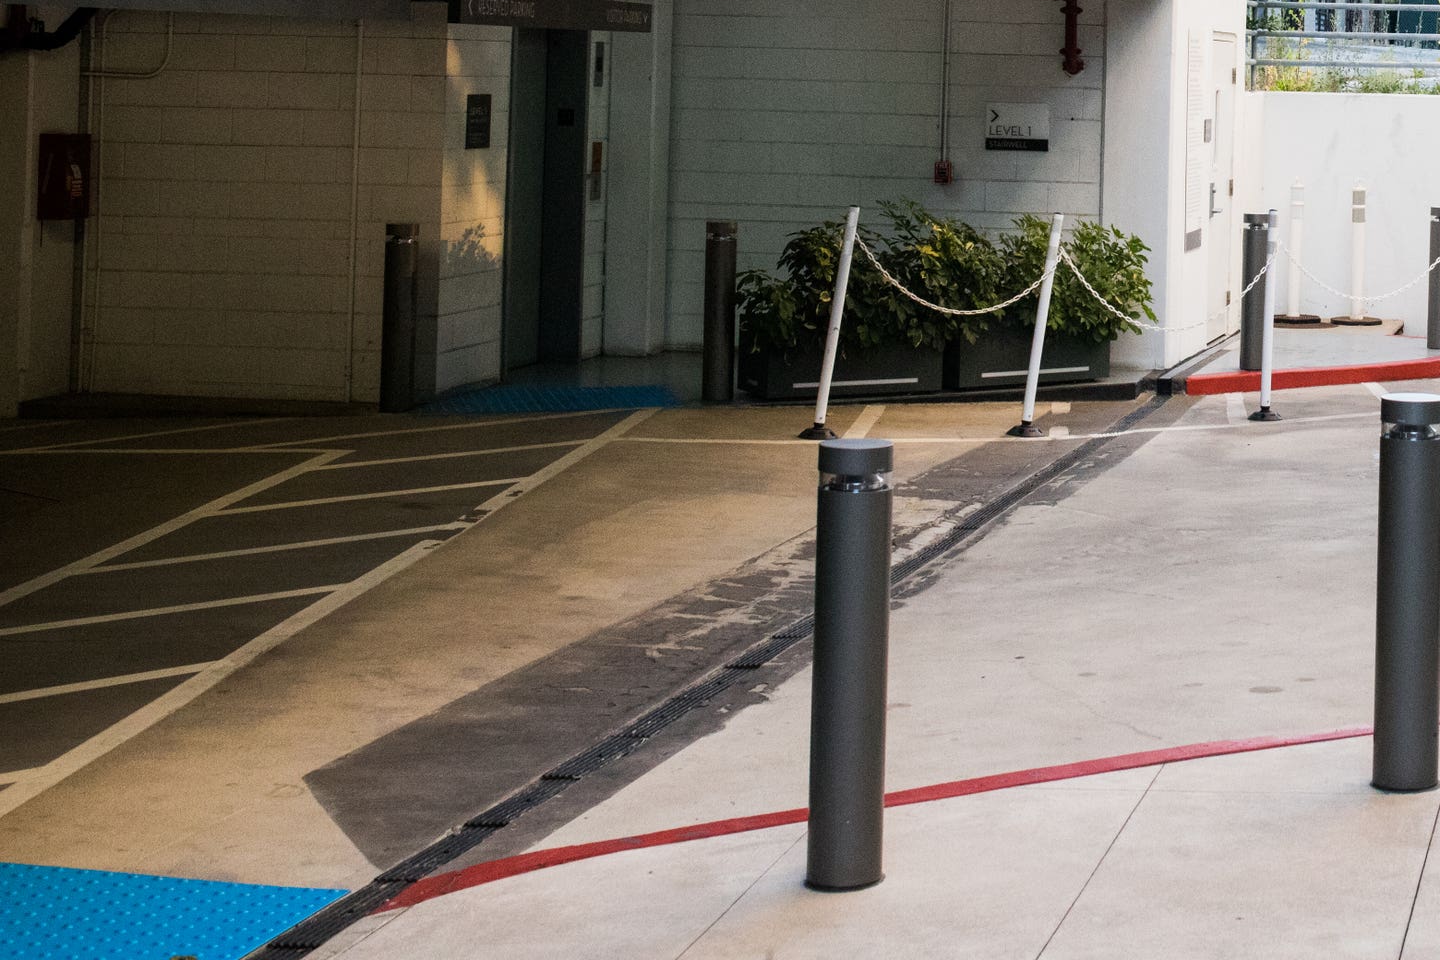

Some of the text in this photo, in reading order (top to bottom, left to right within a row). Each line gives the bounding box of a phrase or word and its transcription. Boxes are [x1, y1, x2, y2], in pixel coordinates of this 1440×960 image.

[510, 0, 535, 19] PARKING
[989, 125, 1031, 136] LEVEL 1
[988, 140, 1028, 149] STAIRWELL
